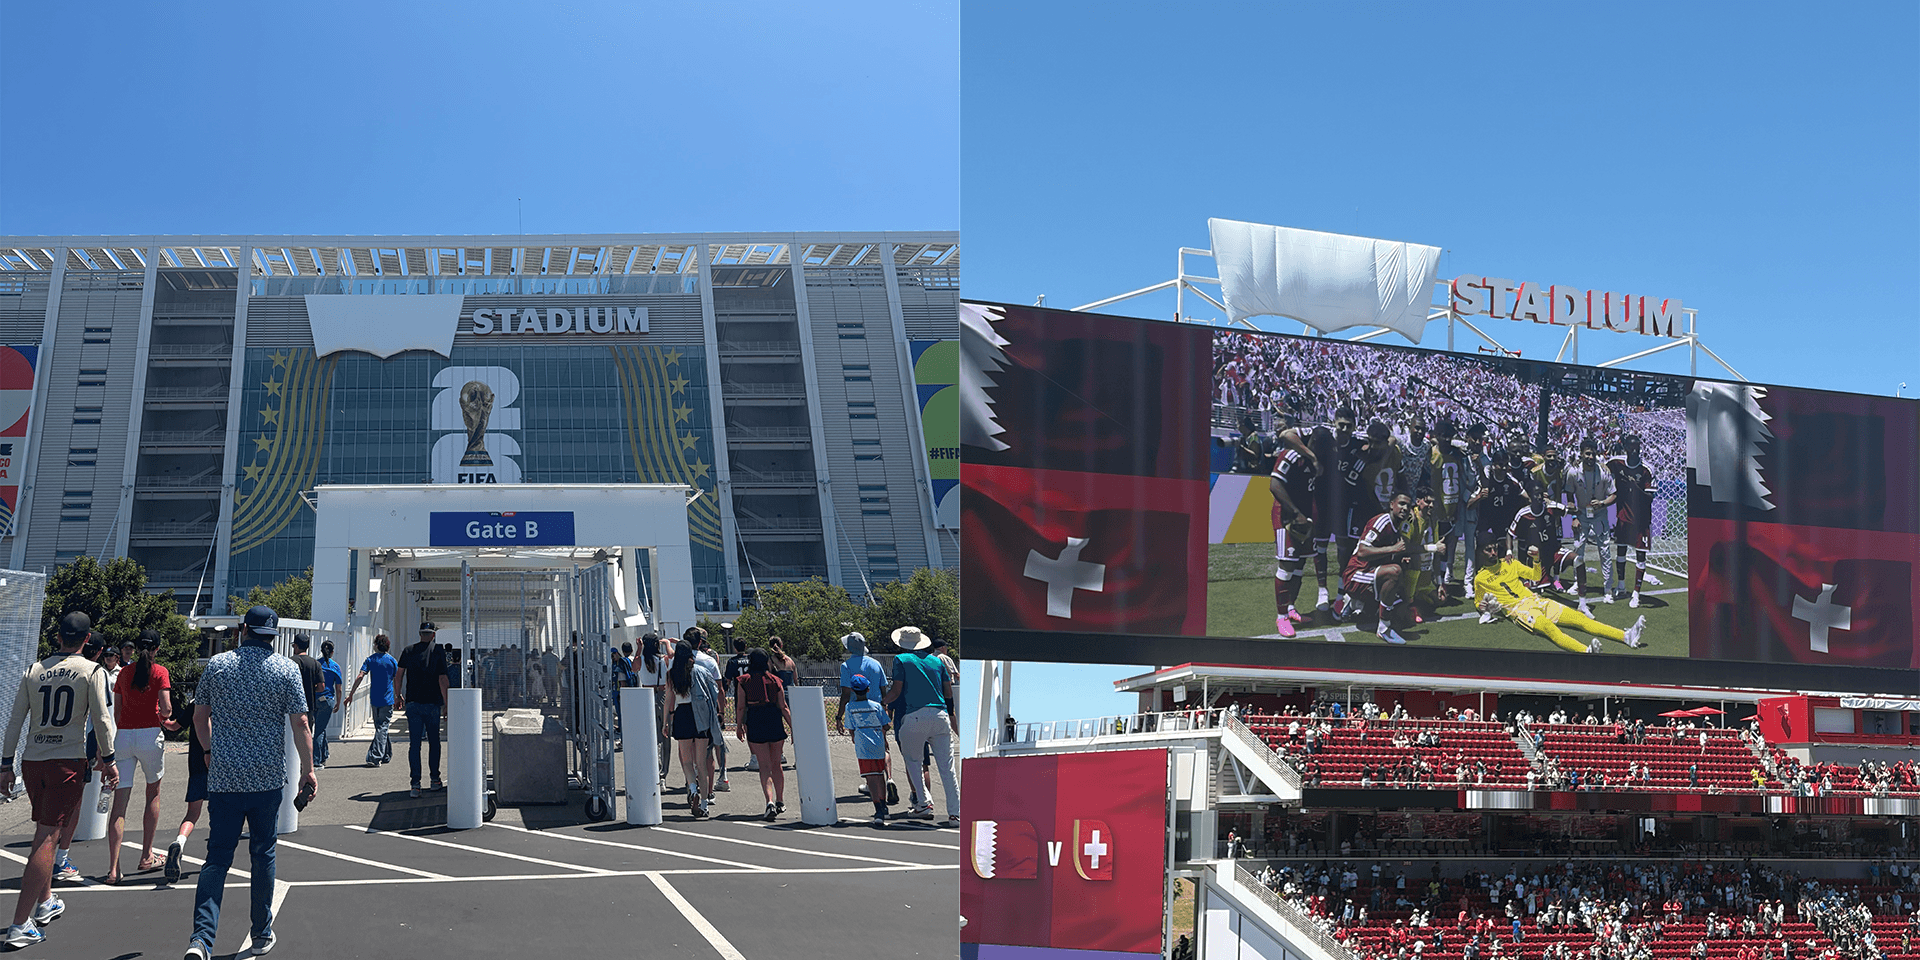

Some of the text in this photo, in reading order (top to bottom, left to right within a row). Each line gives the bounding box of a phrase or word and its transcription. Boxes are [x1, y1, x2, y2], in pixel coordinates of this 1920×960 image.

[1453, 273, 1683, 338] STADIUM
[473, 307, 650, 335] STADIUM
[465, 521, 539, 539] Gate B
[38, 685, 75, 727] 10
[1329, 692, 1360, 700] SPIRTS
